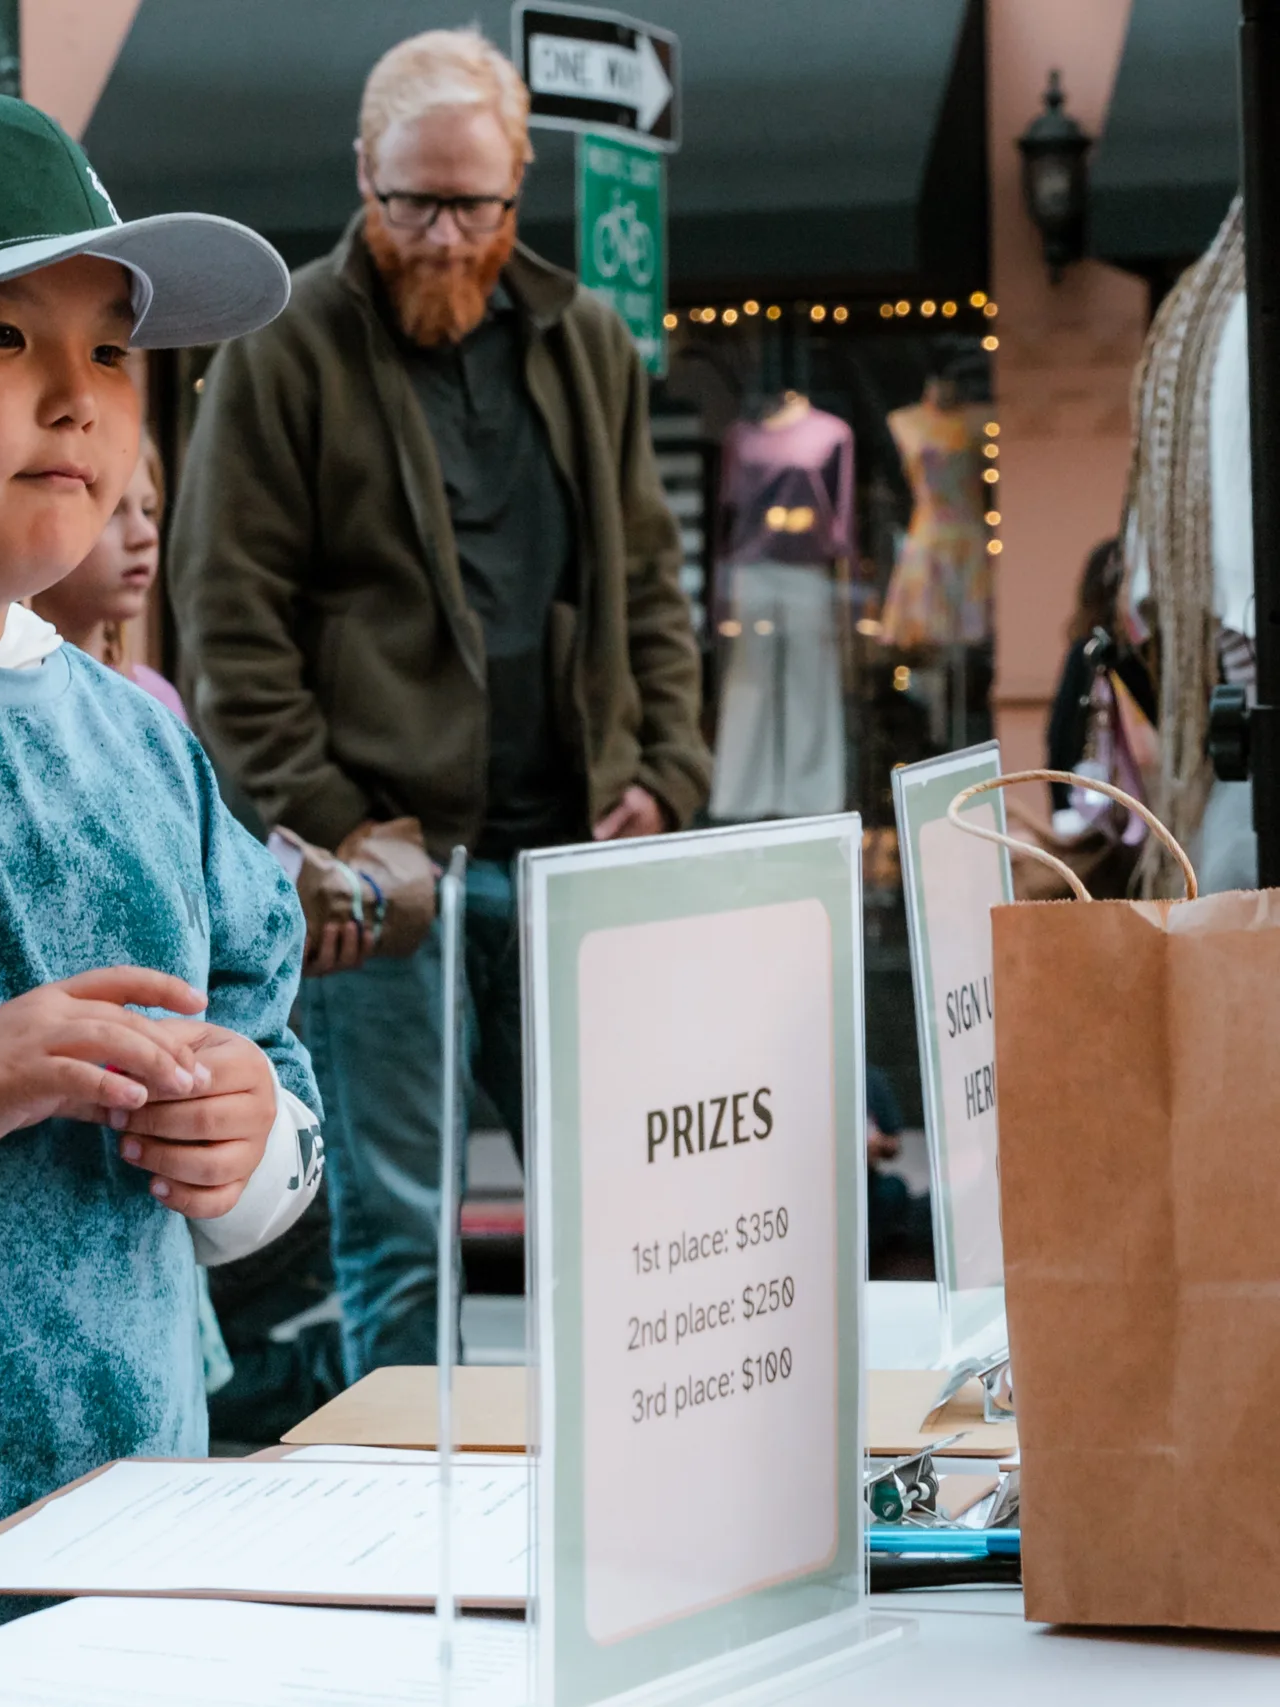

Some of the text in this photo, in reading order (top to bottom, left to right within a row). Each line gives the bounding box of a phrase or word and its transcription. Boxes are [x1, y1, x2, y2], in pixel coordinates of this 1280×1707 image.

[946, 982, 982, 1038] SIGN
[646, 1087, 774, 1165] PRIZES
[631, 1206, 789, 1275] 1st place: $350
[627, 1275, 795, 1351] 2nd place: $250
[631, 1346, 793, 1424] 3rd place: $100
